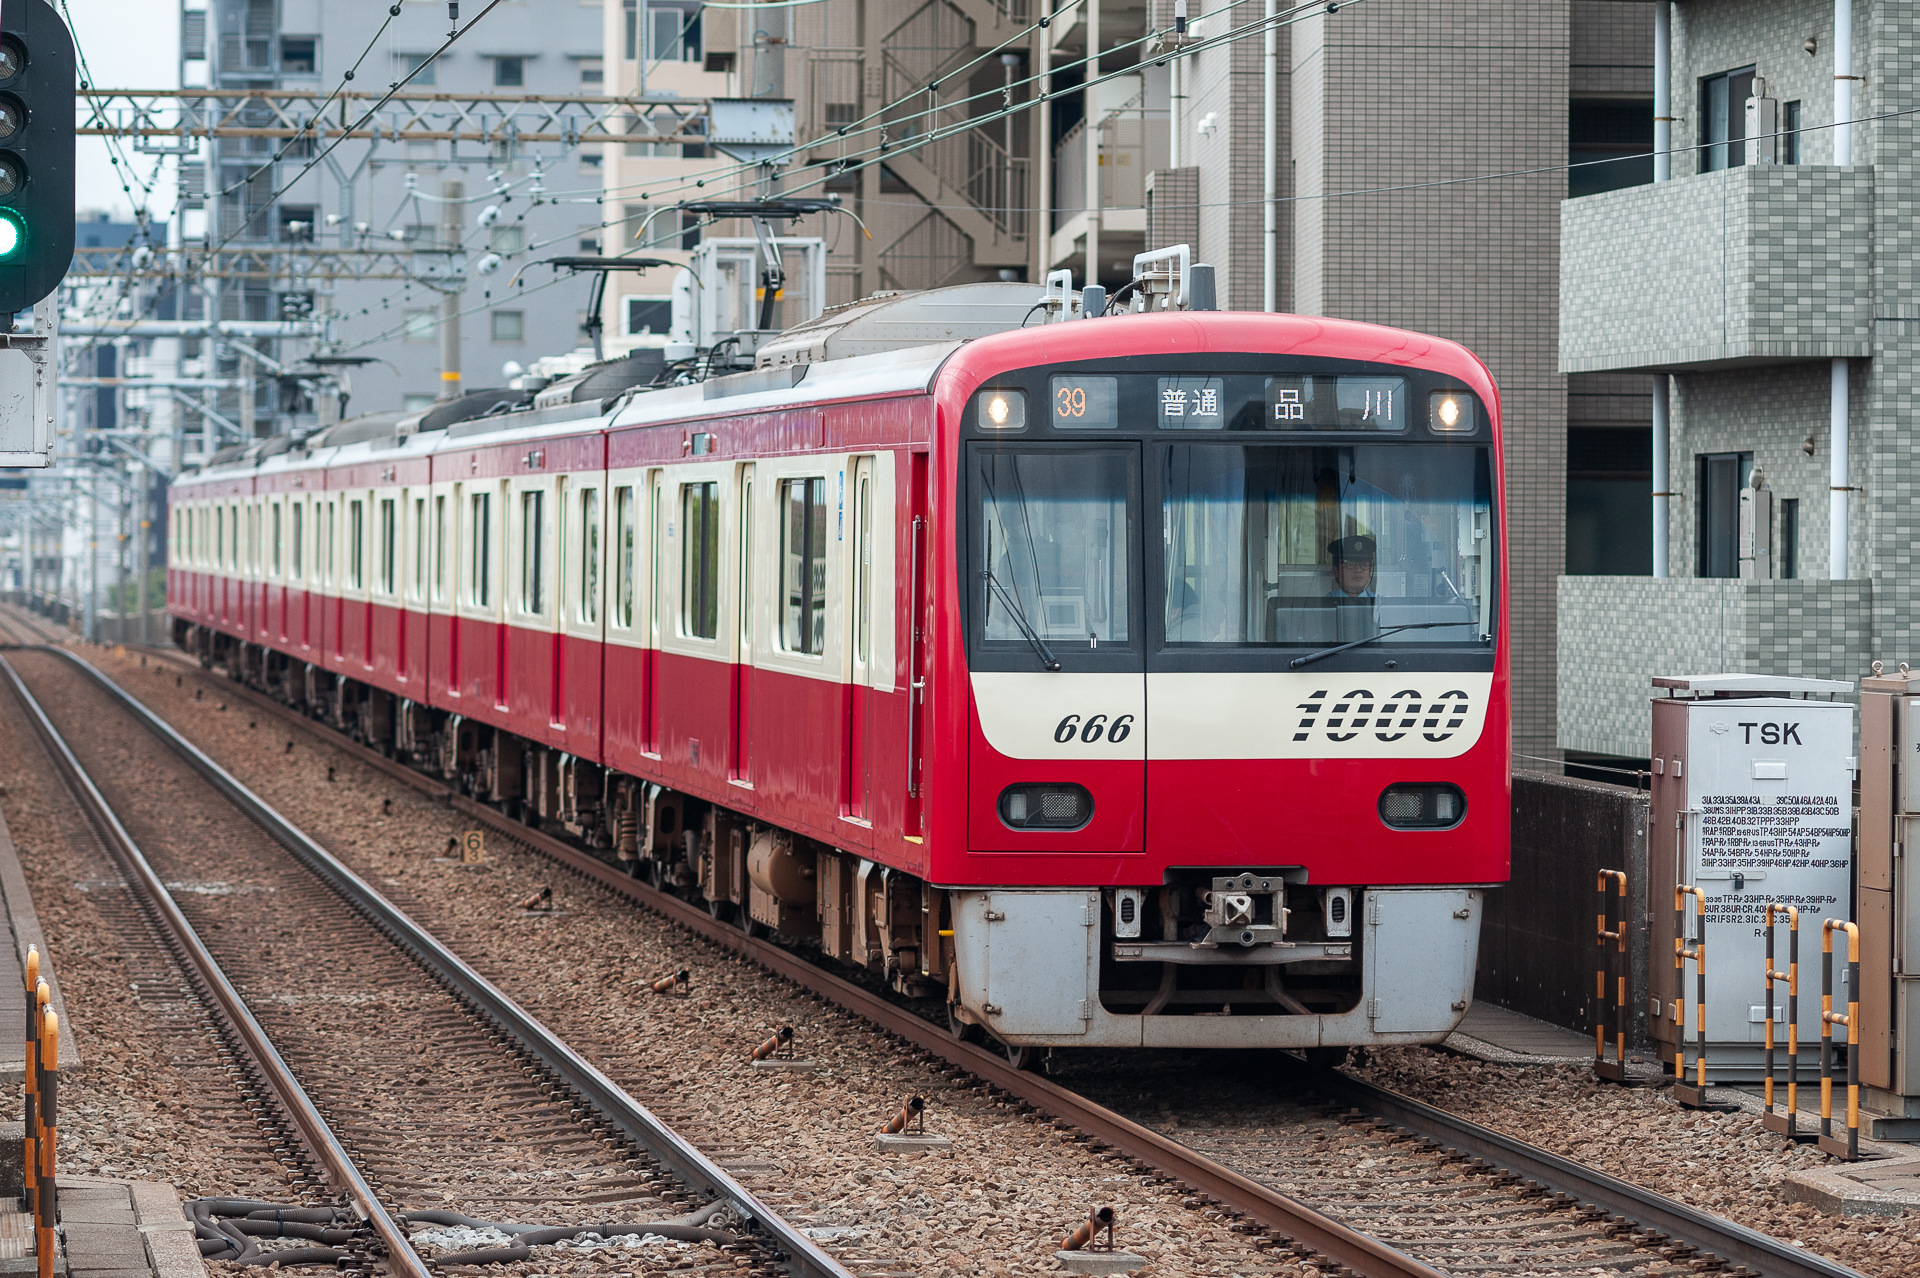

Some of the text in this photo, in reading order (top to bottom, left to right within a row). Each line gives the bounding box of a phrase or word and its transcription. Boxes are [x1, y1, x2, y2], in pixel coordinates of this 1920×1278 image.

[1057, 388, 1087, 418] 39
[1161, 389, 1219, 416] 普通
[1053, 714, 1134, 743] 666
[1292, 689, 1469, 742] 1000
[1738, 722, 1802, 745] TSK
[467, 833, 481, 850] 6
